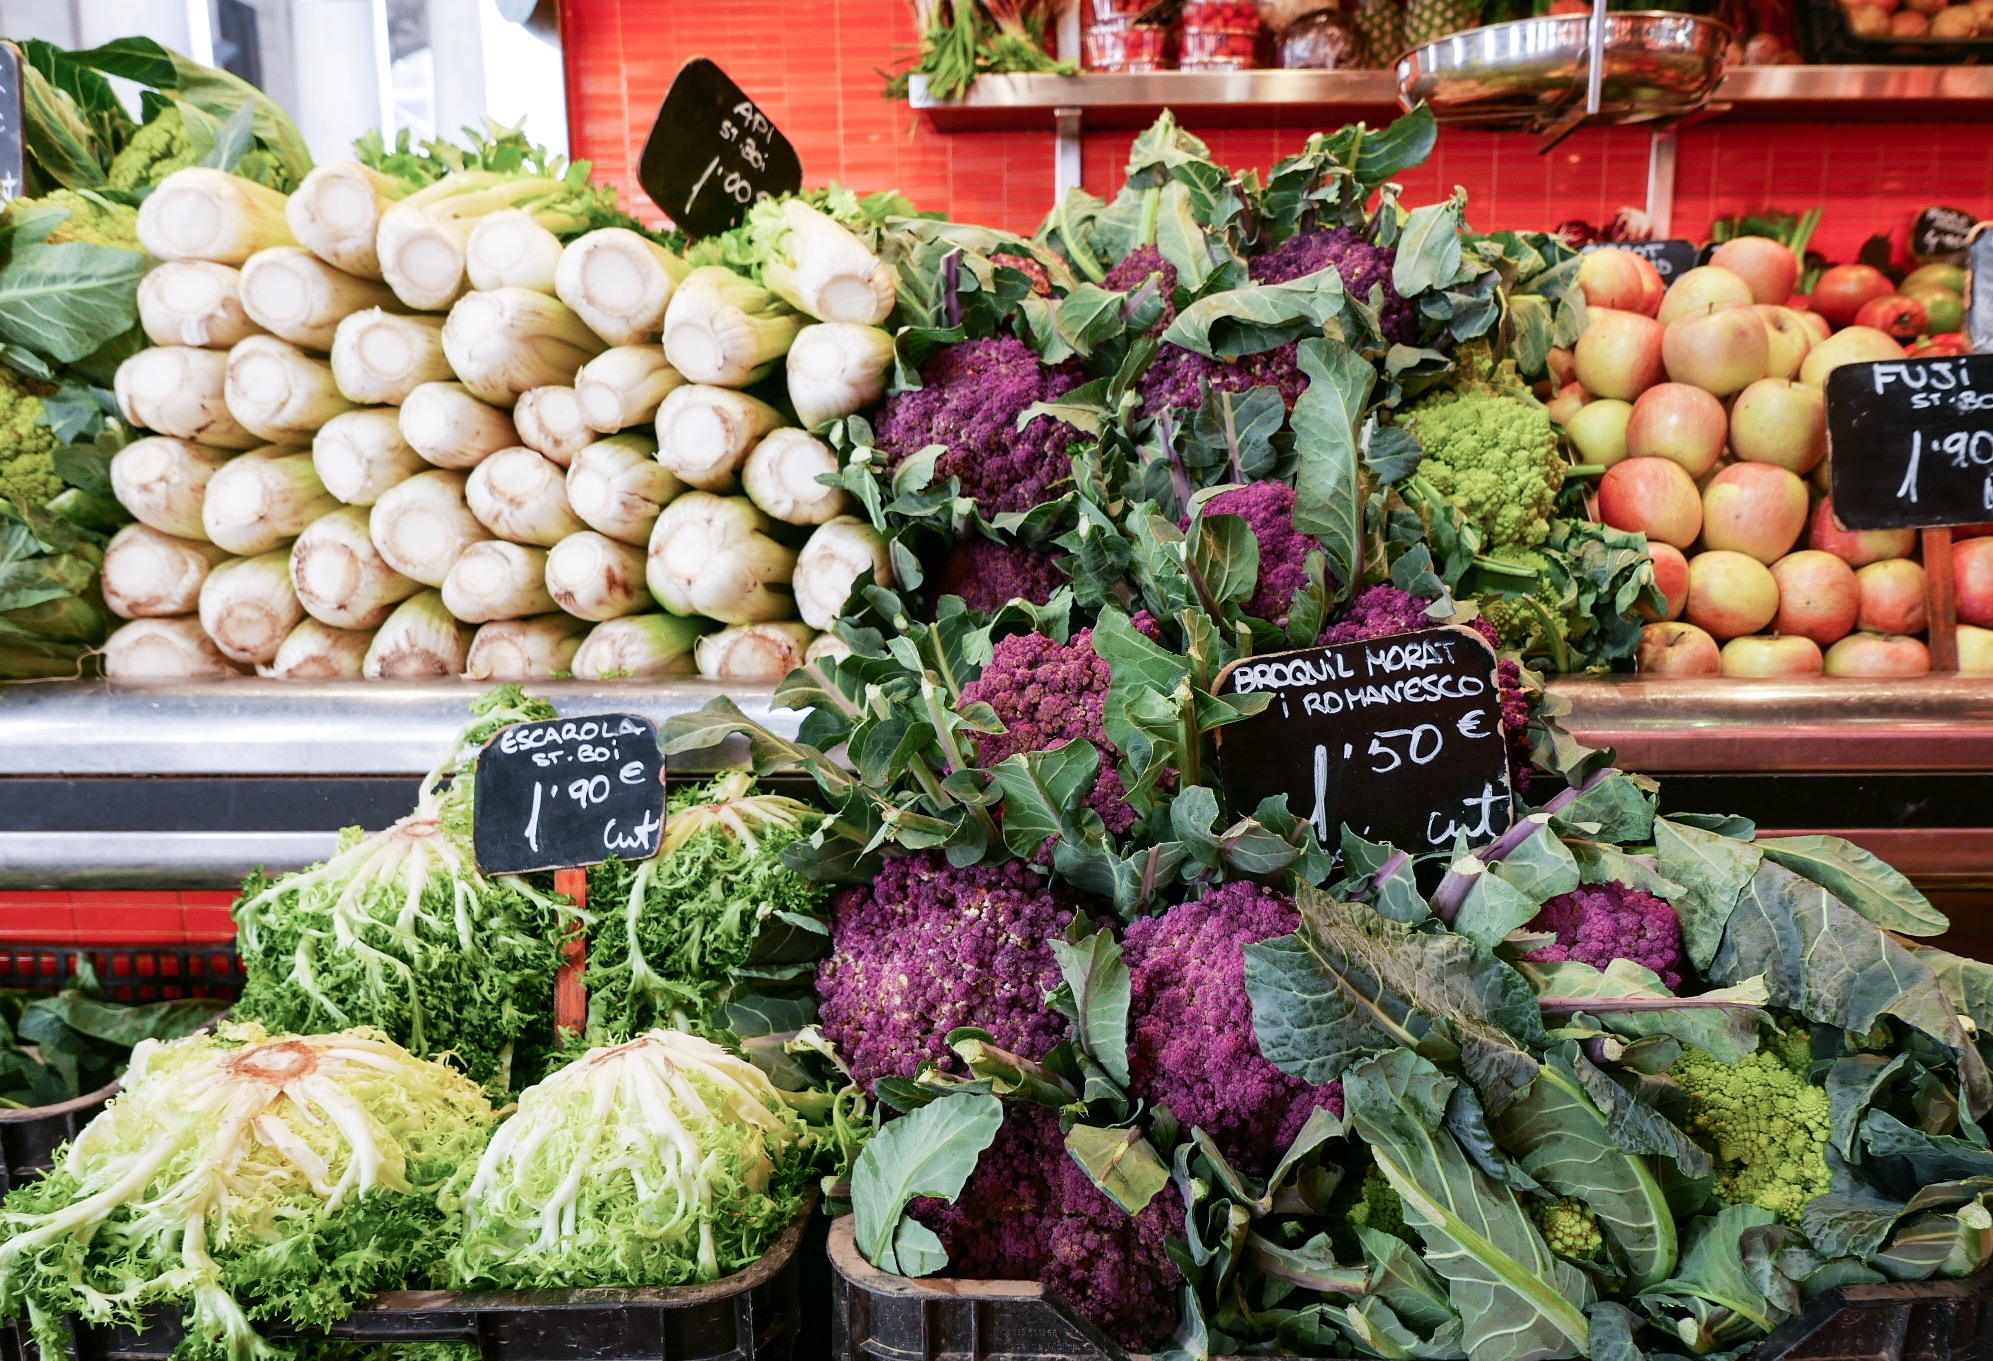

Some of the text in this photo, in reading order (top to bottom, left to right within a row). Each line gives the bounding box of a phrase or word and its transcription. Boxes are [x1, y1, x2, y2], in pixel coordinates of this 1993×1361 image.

[1366, 641, 1456, 677] MORAT
[1302, 675, 1484, 716] ROMANESCO
[500, 717, 647, 754] ESCAROLA
